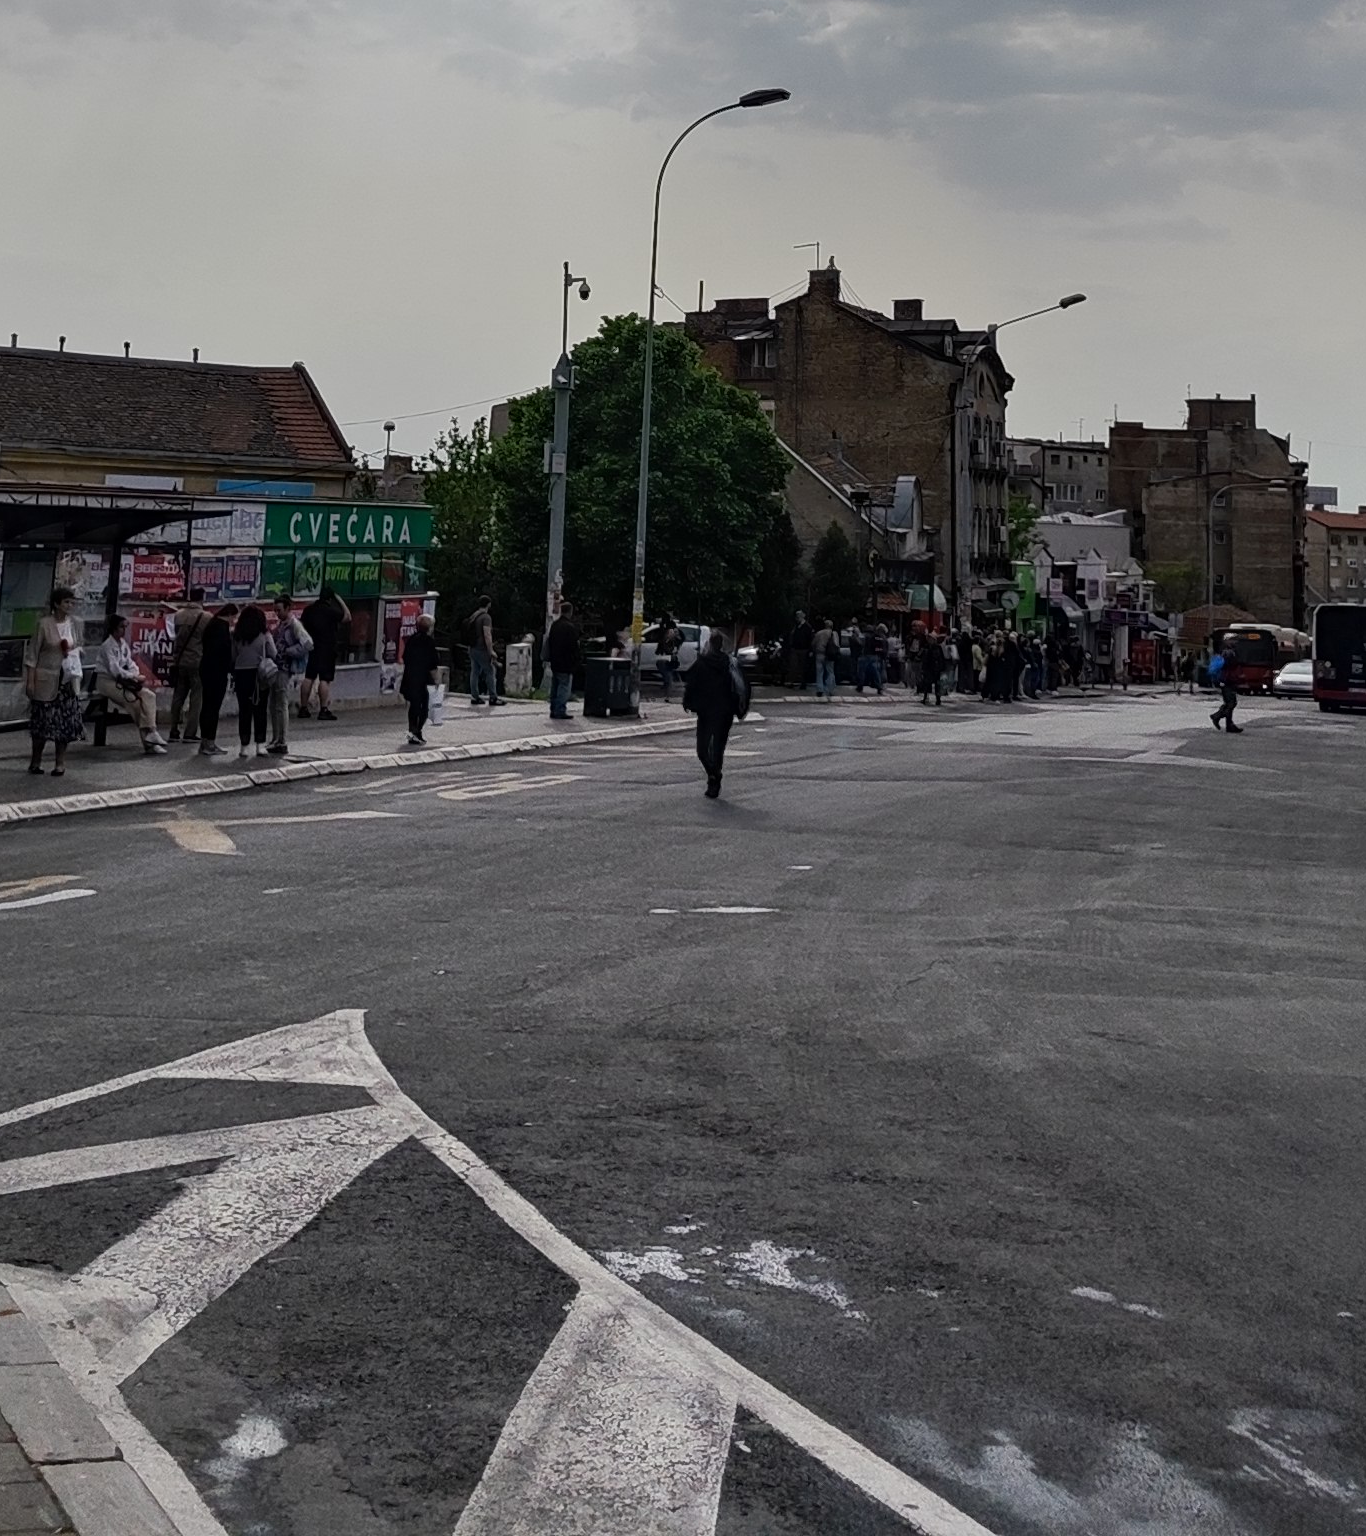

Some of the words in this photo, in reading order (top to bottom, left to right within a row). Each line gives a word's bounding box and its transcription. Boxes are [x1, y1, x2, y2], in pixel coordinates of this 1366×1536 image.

[289, 507, 412, 544] CVEĆARA
[325, 566, 351, 582] BUTIK
[138, 628, 169, 641] IMA
